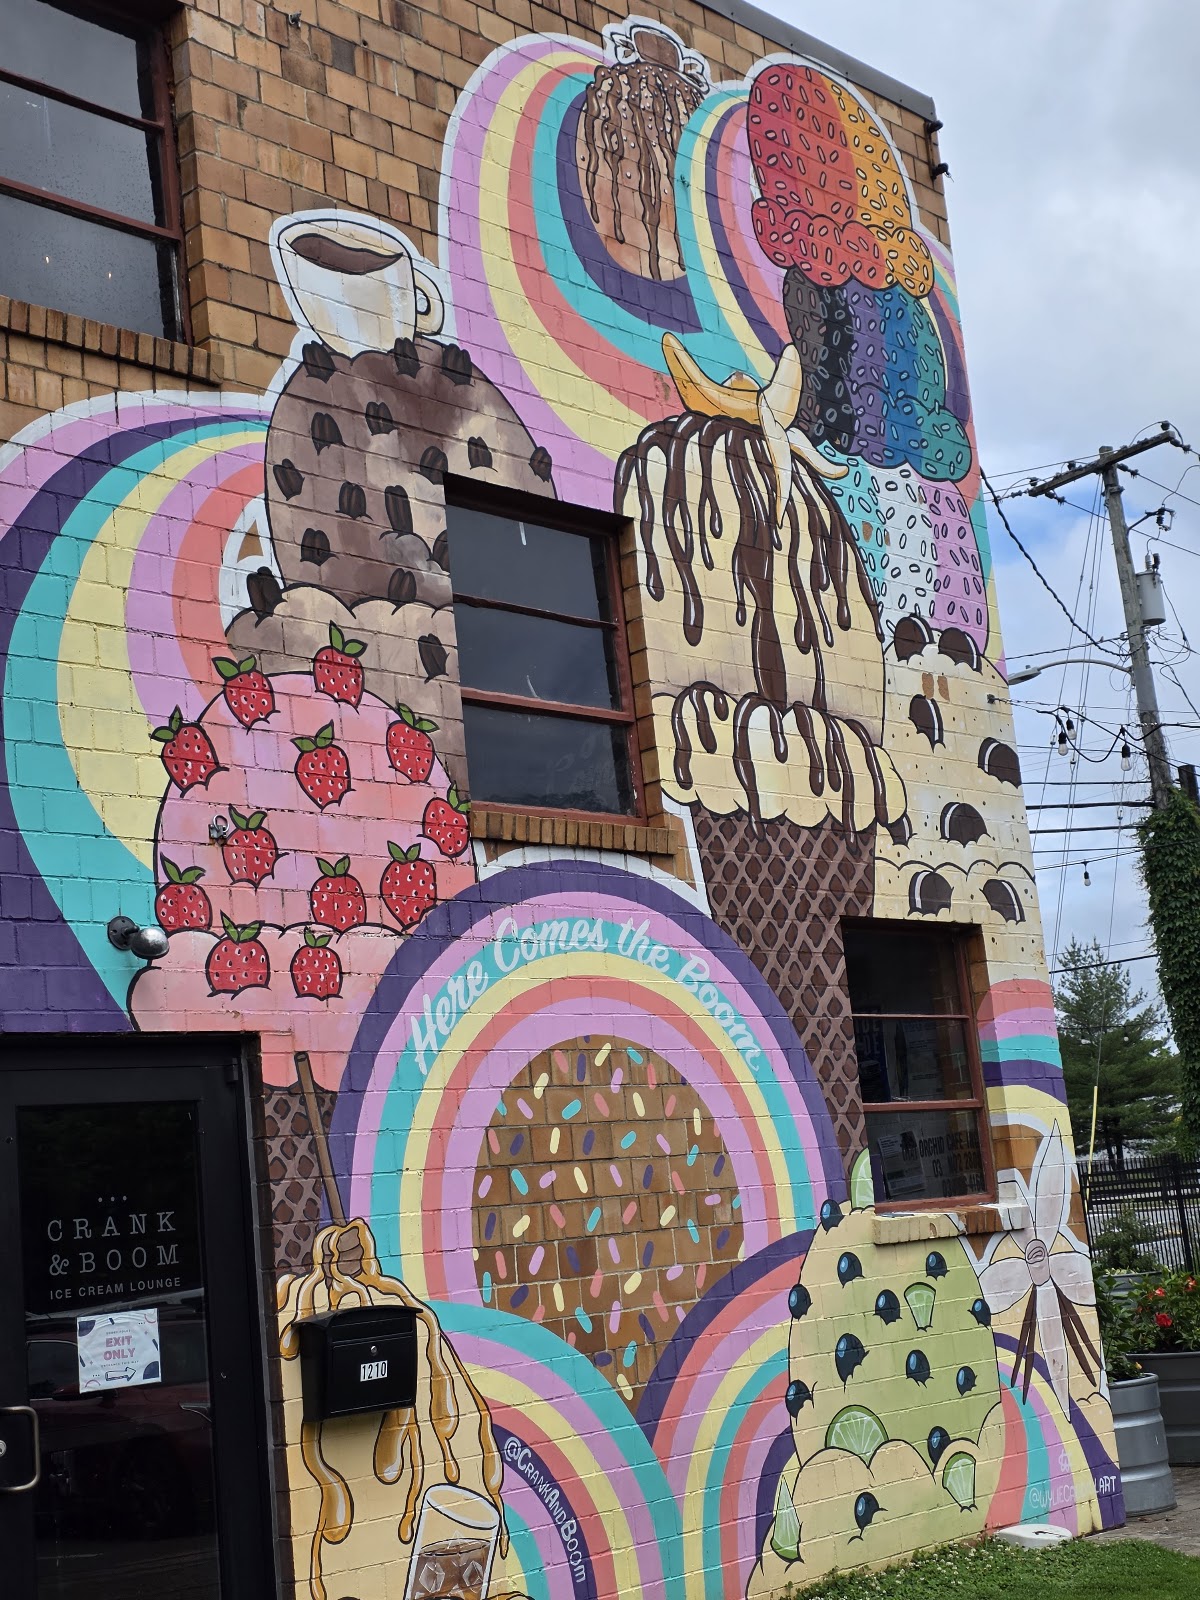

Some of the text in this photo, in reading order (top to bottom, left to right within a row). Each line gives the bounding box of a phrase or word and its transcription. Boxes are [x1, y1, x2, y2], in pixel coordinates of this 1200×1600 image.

[410, 917, 761, 1075] Here Comes the Boom
[47, 1211, 176, 1242] CRANK
[49, 1244, 180, 1276] & BOOM
[50, 1277, 181, 1300] ICE CREAM LOUNGE
[105, 1335, 132, 1347] EXIT
[103, 1348, 135, 1361] ONLY
[362, 1361, 387, 1380] 1210
